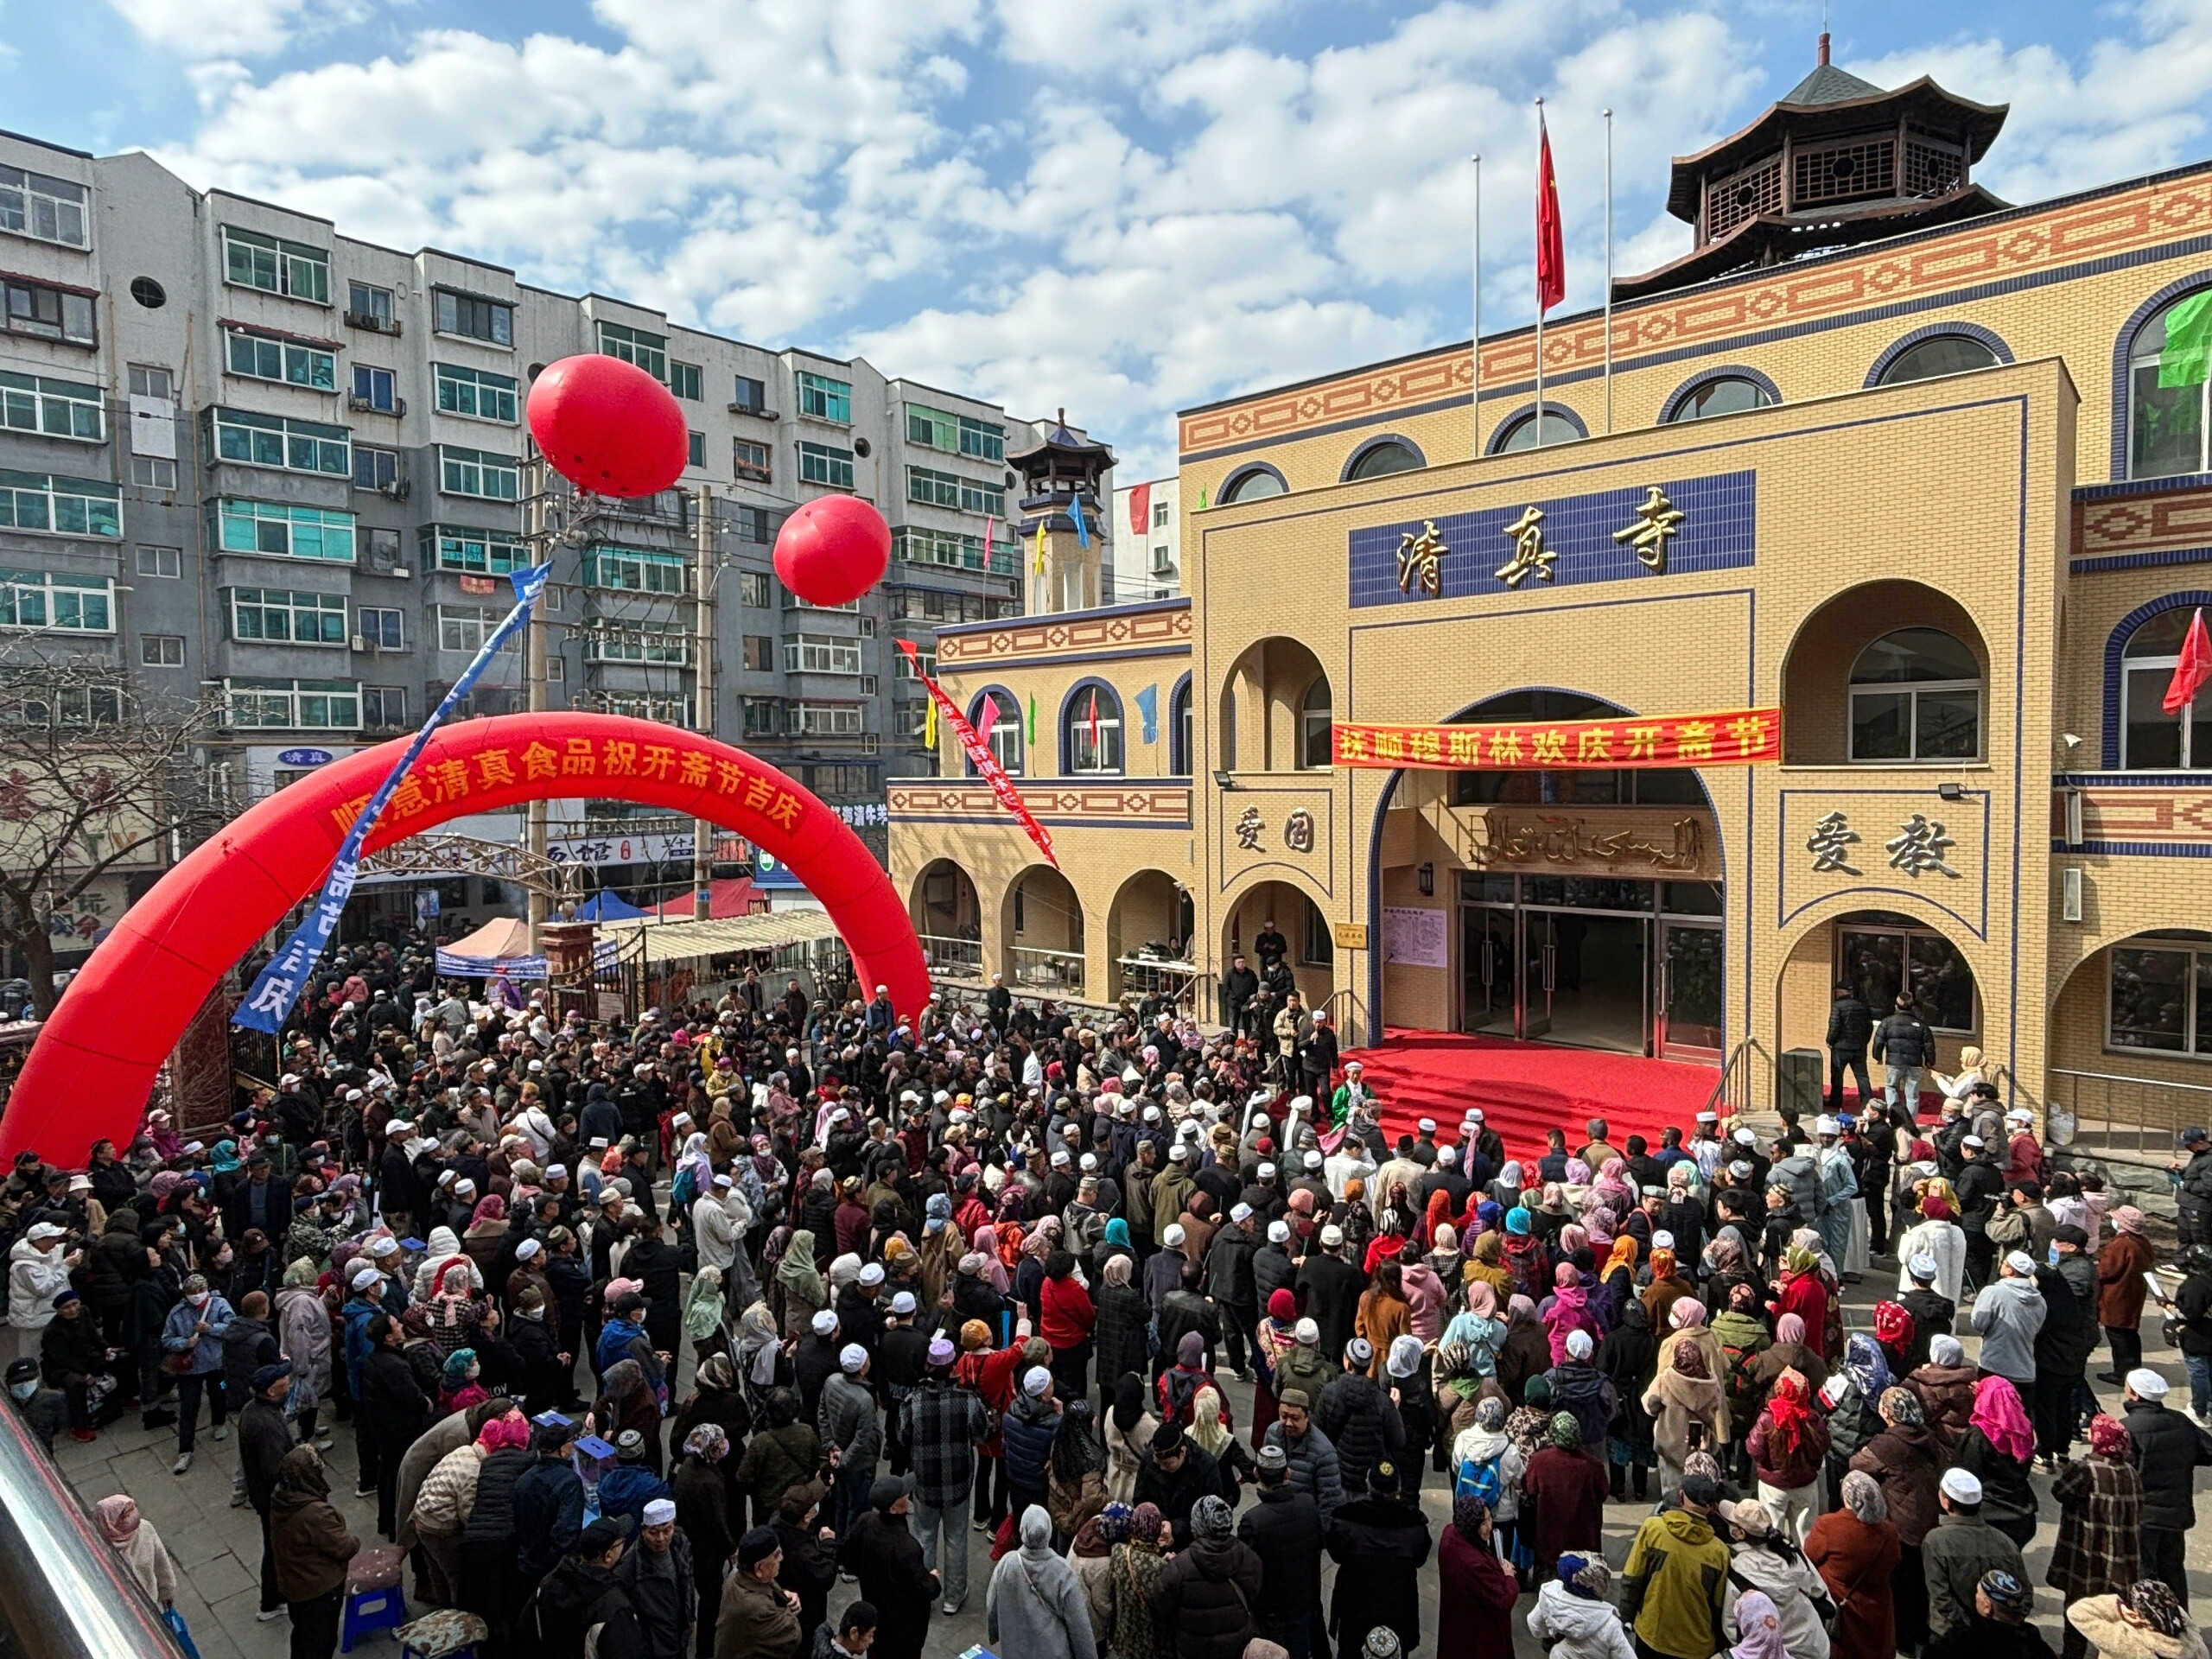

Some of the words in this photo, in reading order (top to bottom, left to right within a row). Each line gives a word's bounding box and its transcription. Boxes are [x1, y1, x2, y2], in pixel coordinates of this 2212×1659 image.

[1395, 486, 1685, 598] 清真寺
[1338, 714, 1774, 767] 抚顺穆斯林欢庆开斋节
[330, 737, 804, 836] 顺意清真食品祝开斋节吉庆
[1235, 804, 1314, 854] 爱国
[1806, 810, 1963, 879] 爱教
